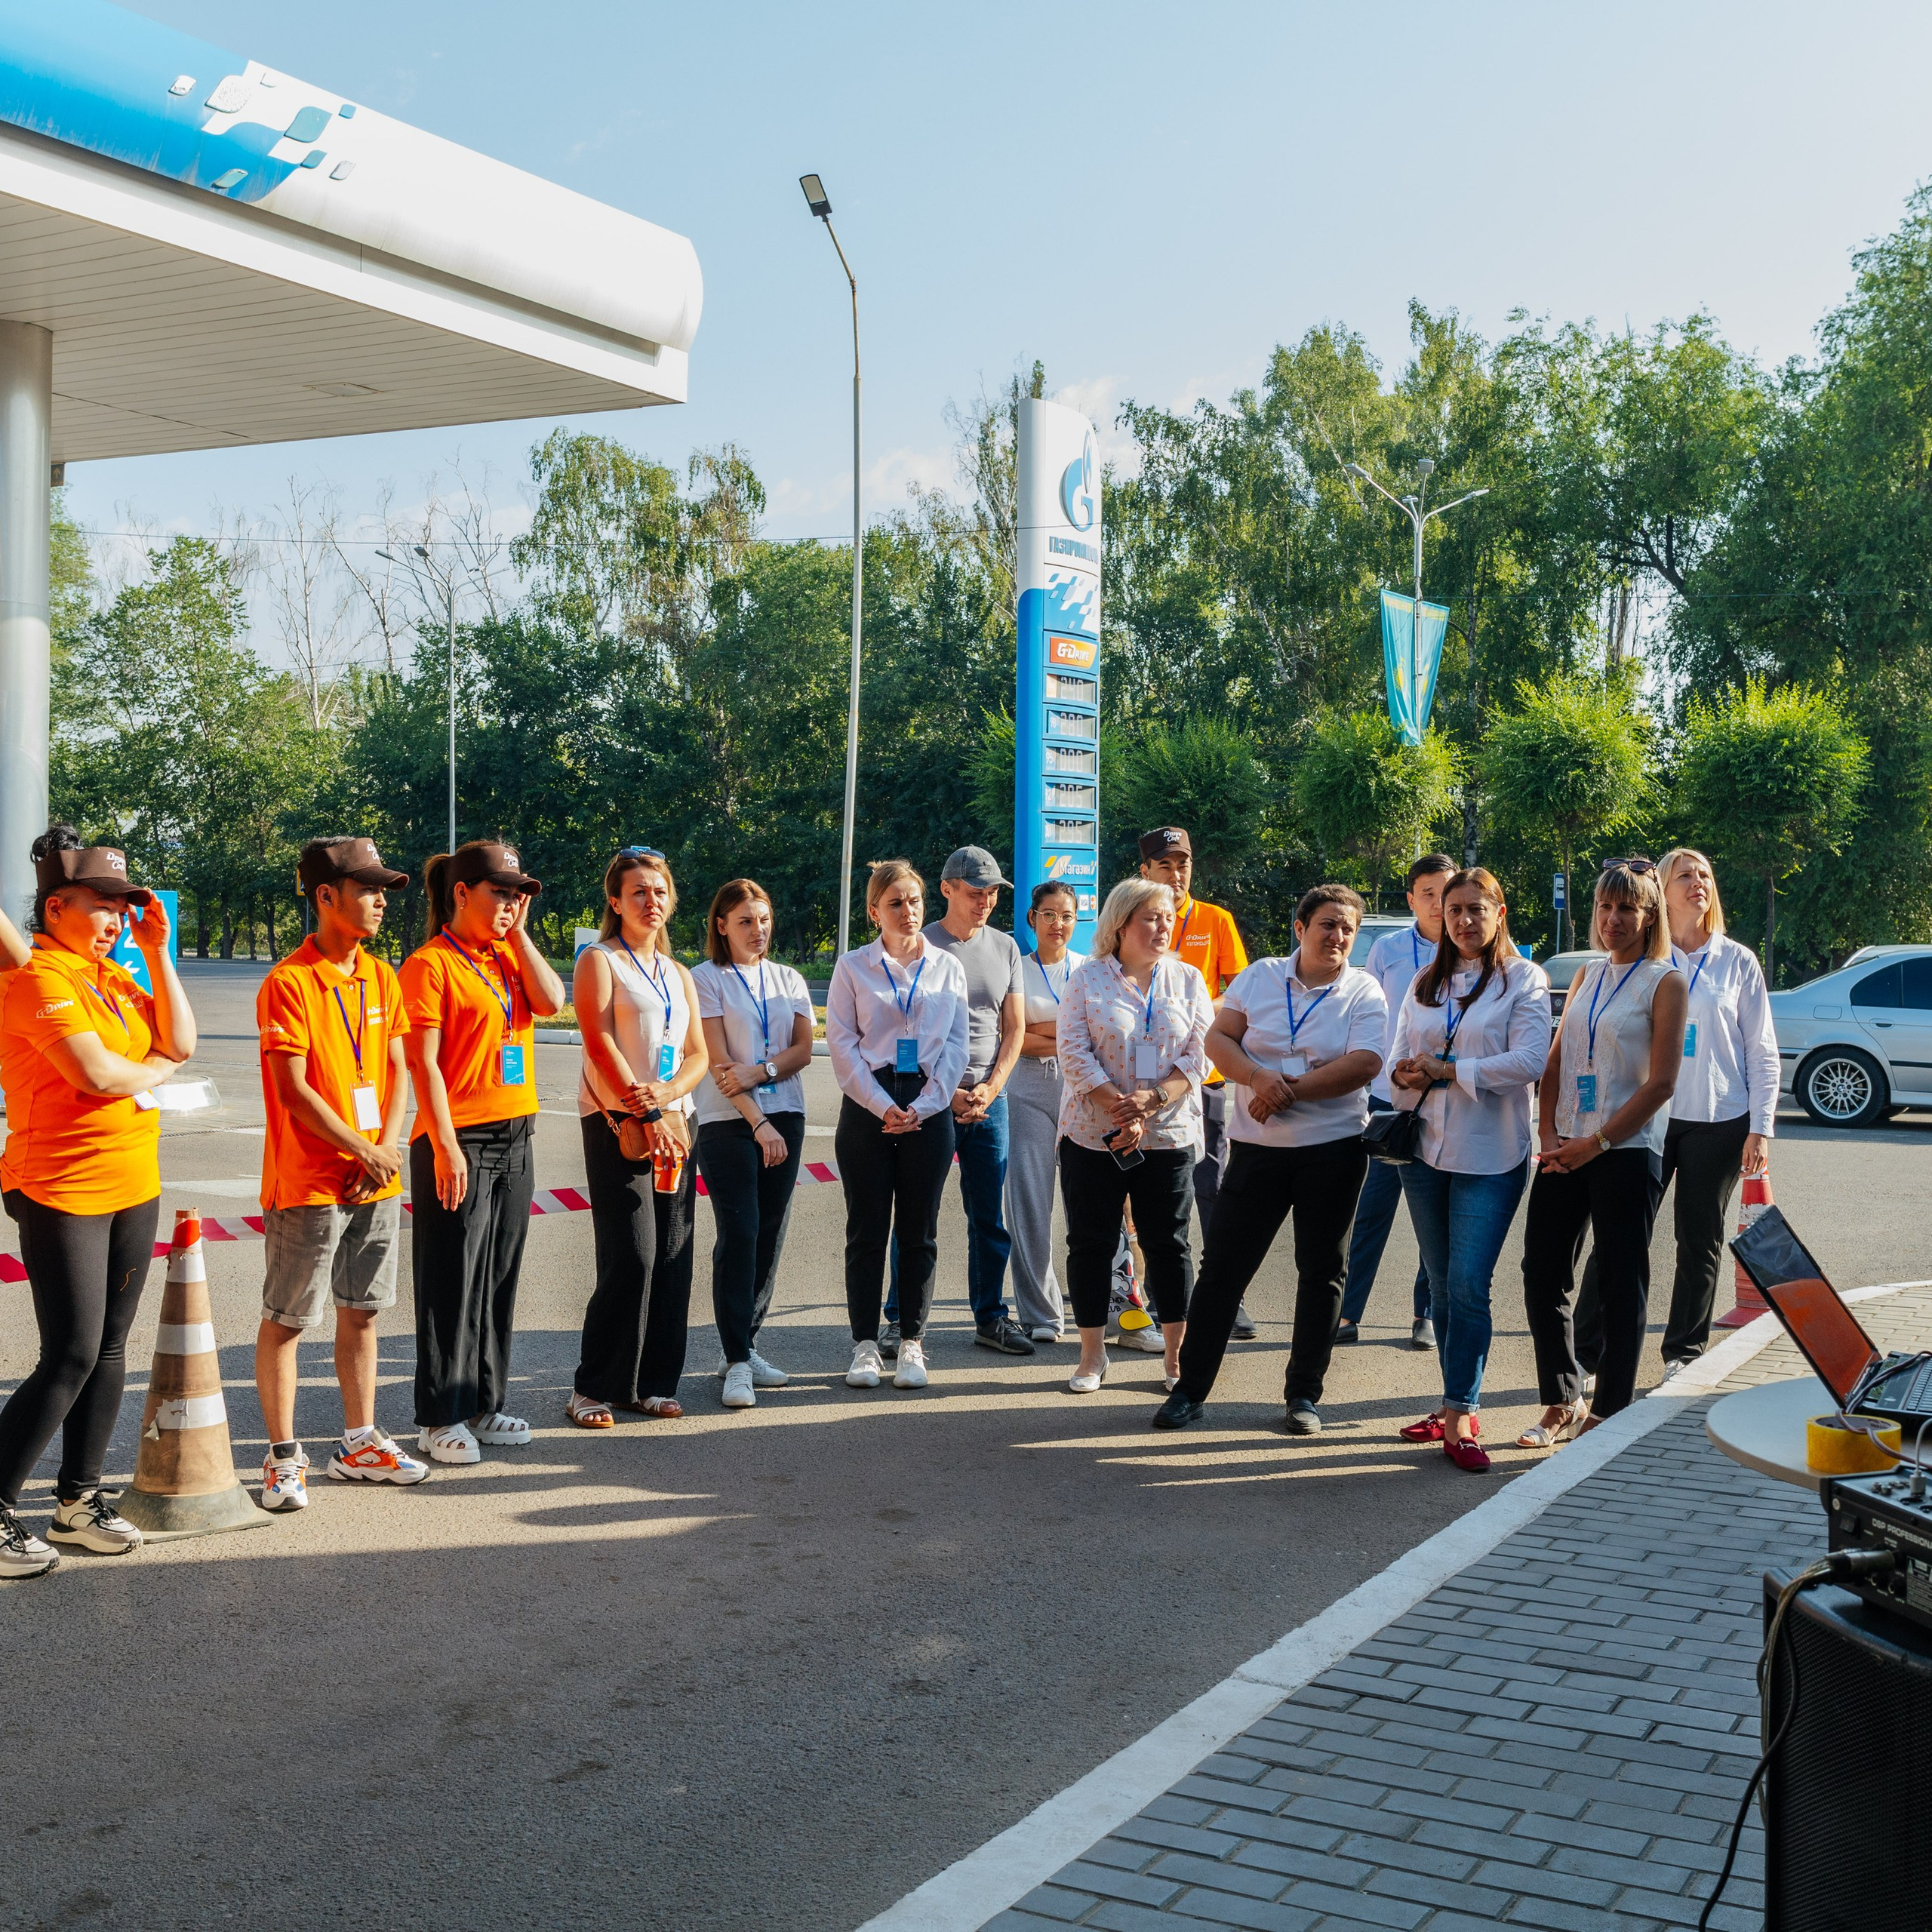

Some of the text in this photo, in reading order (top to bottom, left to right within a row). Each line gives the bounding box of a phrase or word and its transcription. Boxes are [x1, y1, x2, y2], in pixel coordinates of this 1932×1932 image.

[1049, 535, 1099, 565] ГАЗПРОМ
[1059, 860, 1091, 875] Магазин
[1872, 1517, 1886, 1530] DSP
